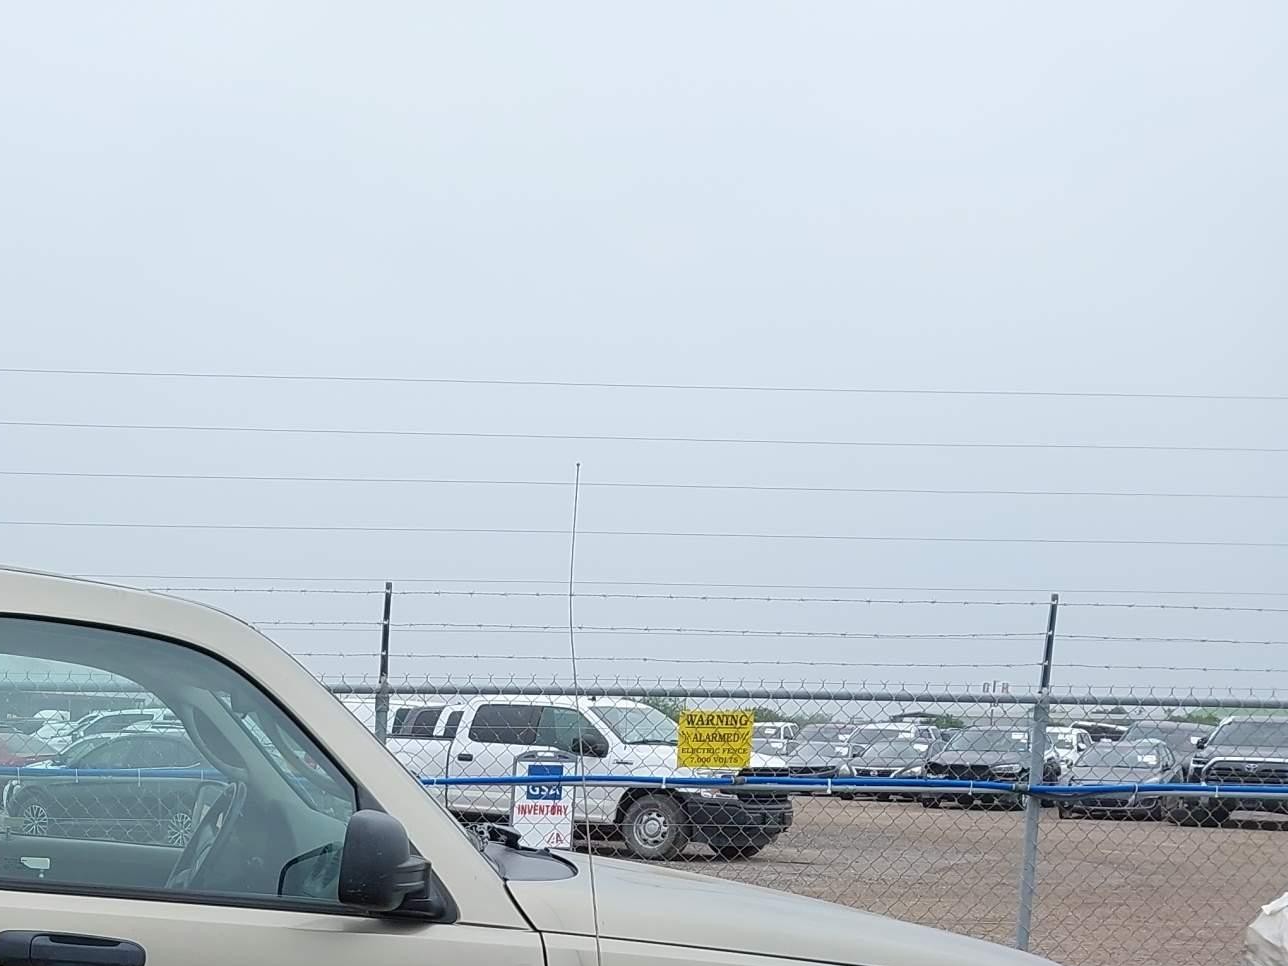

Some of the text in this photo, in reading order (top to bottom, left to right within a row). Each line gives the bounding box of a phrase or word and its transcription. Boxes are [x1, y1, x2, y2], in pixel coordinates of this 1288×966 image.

[686, 714, 748, 726] WARNING
[692, 732, 740, 742] ALARMED
[722, 747, 748, 755] FENCE
[517, 804, 569, 816] INVENTORY
